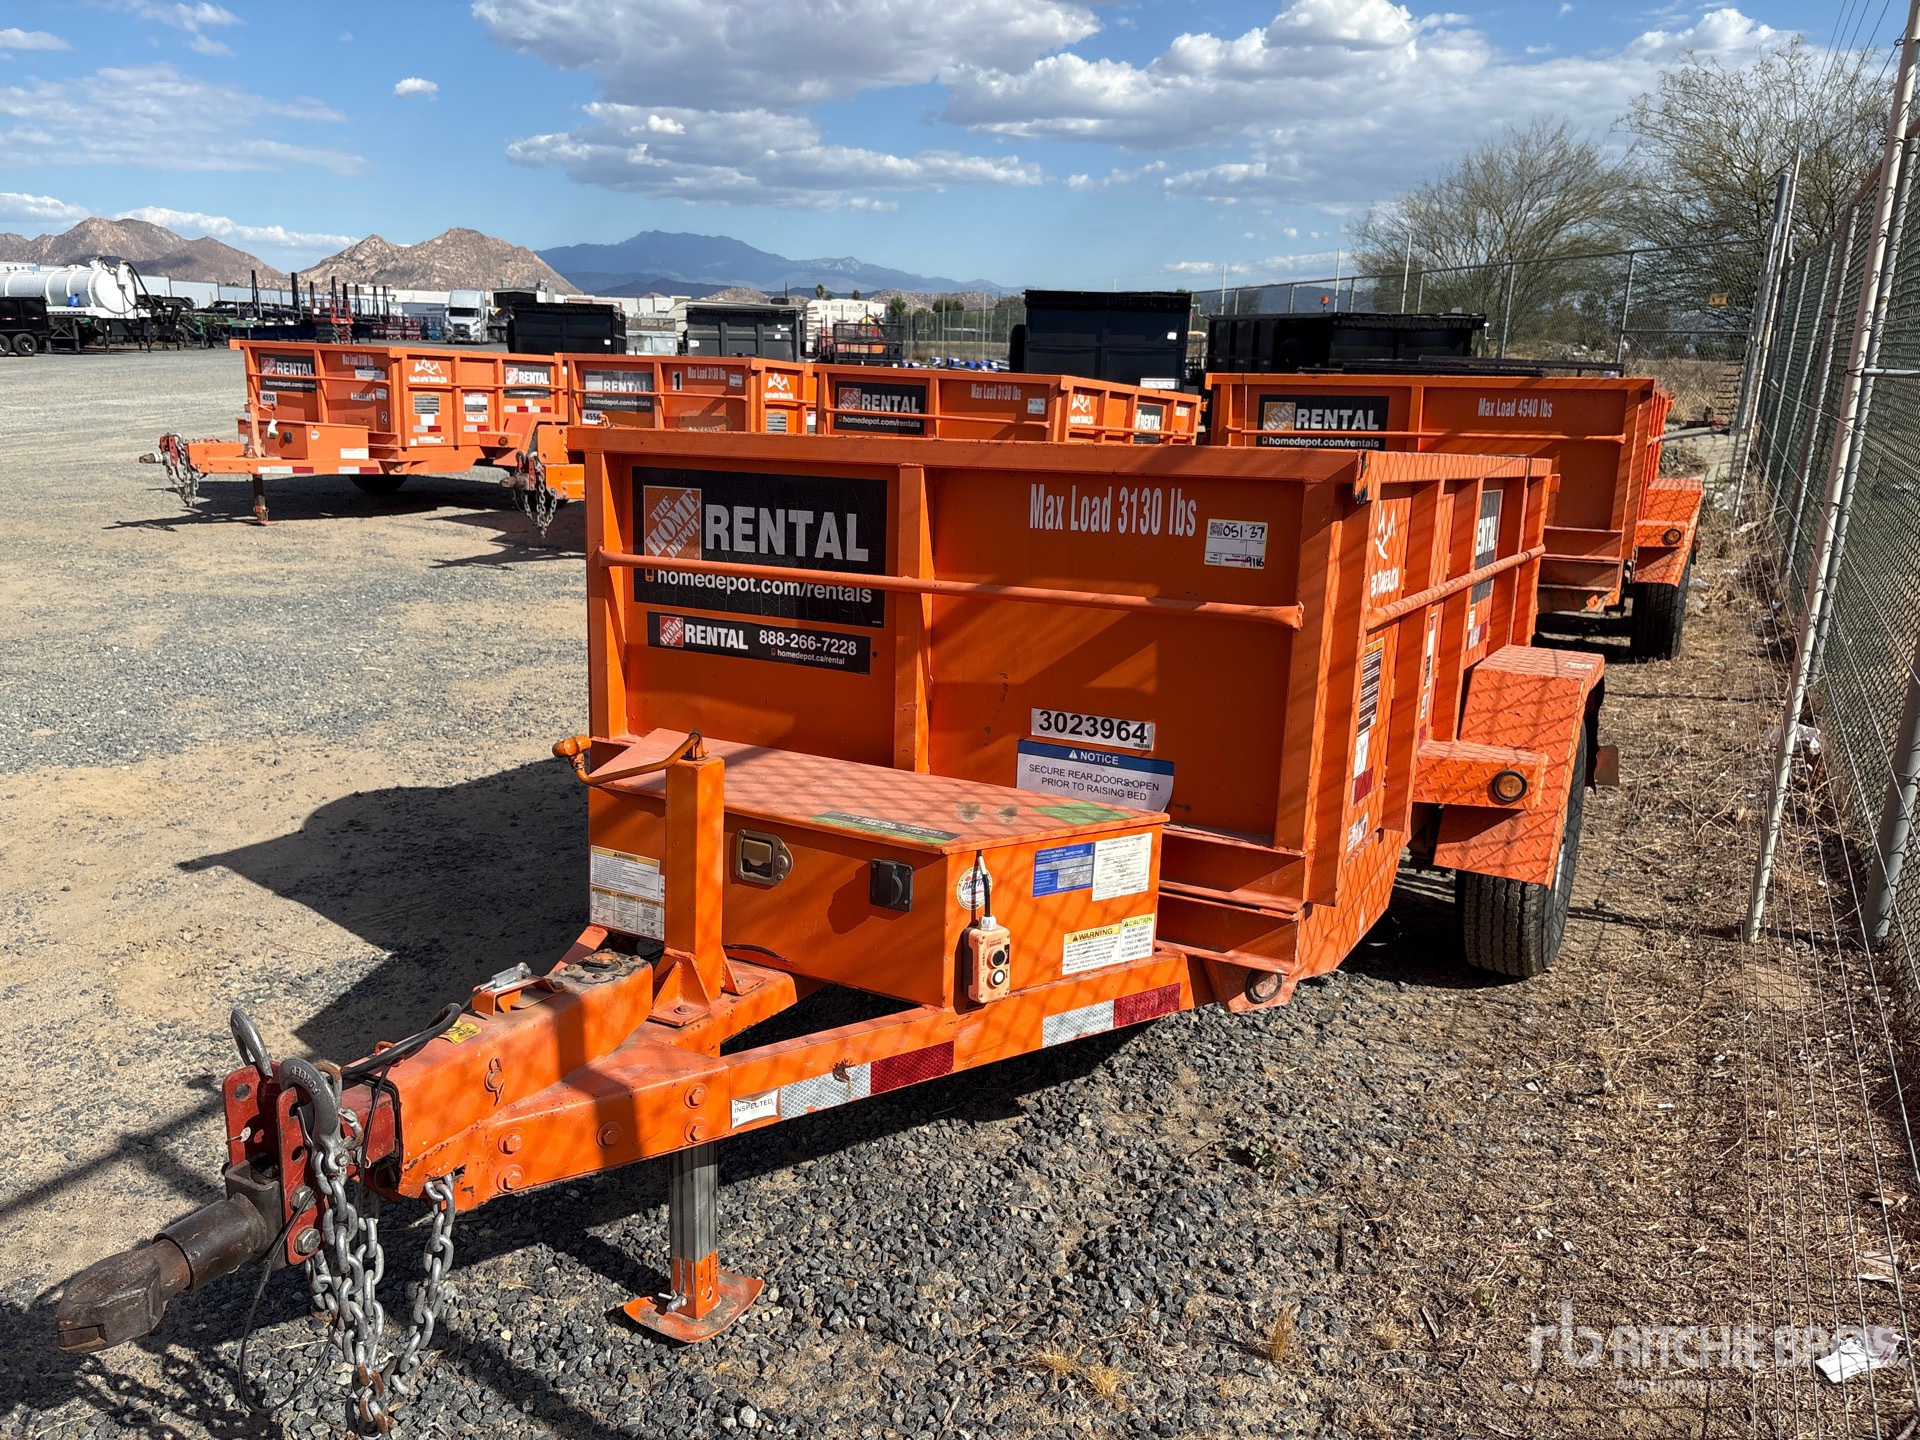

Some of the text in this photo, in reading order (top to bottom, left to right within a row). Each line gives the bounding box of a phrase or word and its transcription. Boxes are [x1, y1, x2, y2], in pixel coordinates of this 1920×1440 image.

[276, 361, 315, 376] RENTAL
[518, 370, 550, 385] RENTAL
[687, 366, 697, 379] Max
[697, 367, 708, 380] Load
[719, 368, 727, 380] lbs
[603, 380, 649, 393] RENTAL
[674, 372, 681, 390] 1
[262, 394, 276, 402] 4555
[970, 383, 983, 399] Max
[983, 384, 997, 400] Load
[1012, 386, 1022, 401] lbs
[590, 398, 651, 407] homedepot.com/rentals
[861, 394, 920, 413] RENTAL
[1477, 398, 1553, 418] Max Load 4540 lbs
[382, 412, 387, 423] 2
[842, 415, 921, 428] homedepot.com/rentals
[1295, 409, 1380, 431] RENTAL
[1268, 436, 1380, 448] homedepot.com/rentals
[650, 495, 673, 523] THE
[1029, 483, 1197, 538] Max Load 3130 lbs
[645, 488, 701, 557] HOME
[665, 515, 701, 558] DEPOT
[705, 503, 869, 562] RENTAL
[1475, 516, 1497, 556] ENTAL
[657, 569, 873, 604] homedepot.com/rentals
[684, 623, 857, 656] RENTAL 888-266-7228
[777, 649, 845, 665] homedepot.ca/rental
[1038, 711, 1147, 743] 3023964
[1080, 751, 1119, 765] NOTICE
[1029, 764, 1159, 791] SECURE REAR DOORS OPEN
[1041, 777, 1147, 801] PRIOR TO RAISING BED
[1129, 917, 1153, 926] CAUTION
[1078, 928, 1113, 940] WARNING
[291, 1065, 321, 1095] FORGED
